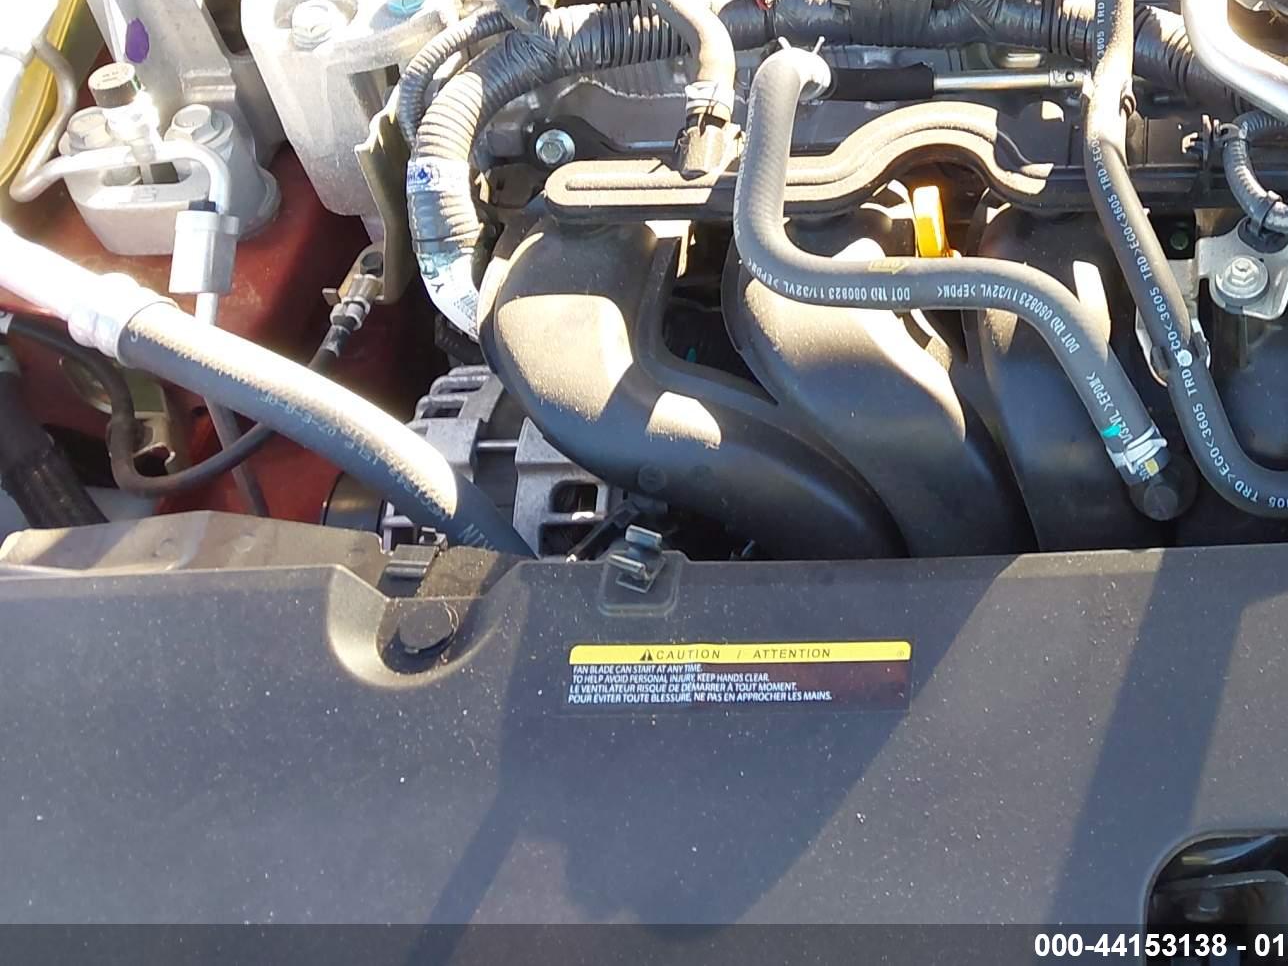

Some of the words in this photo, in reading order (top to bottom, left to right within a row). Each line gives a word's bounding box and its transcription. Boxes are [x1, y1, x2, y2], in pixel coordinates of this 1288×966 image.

[891, 286, 910, 300] DOT
[1061, 333, 1081, 353] DOT
[656, 650, 721, 660] CAUTION
[753, 649, 831, 659] ATTENTION
[572, 665, 588, 674] FAN
[589, 665, 614, 674] BLADE
[615, 665, 633, 674] CAN
[633, 664, 656, 674] START
[657, 664, 666, 673] AT
[667, 664, 683, 674] ANY
[684, 664, 703, 673] TIME.
[572, 674, 584, 684] TO
[584, 674, 604, 684] HELP
[604, 674, 629, 683] AVOID
[629, 673, 669, 683] PERSONAL
[697, 673, 716, 683] KEEP
[717, 673, 744, 682] HANDS
[570, 684, 580, 694] LE
[581, 683, 636, 694] VENTILATEUR
[636, 683, 667, 693] RISQUE
[668, 683, 680, 693] DE
[734, 682, 757, 692] TOUT
[568, 694, 593, 704] POUR
[622, 693, 650, 703] TOUTE
[693, 692, 706, 702] NE
[706, 692, 722, 702] PAS
[723, 692, 736, 702] EN
[736, 691, 787, 702] APPROCHER
[787, 691, 803, 701] LES
